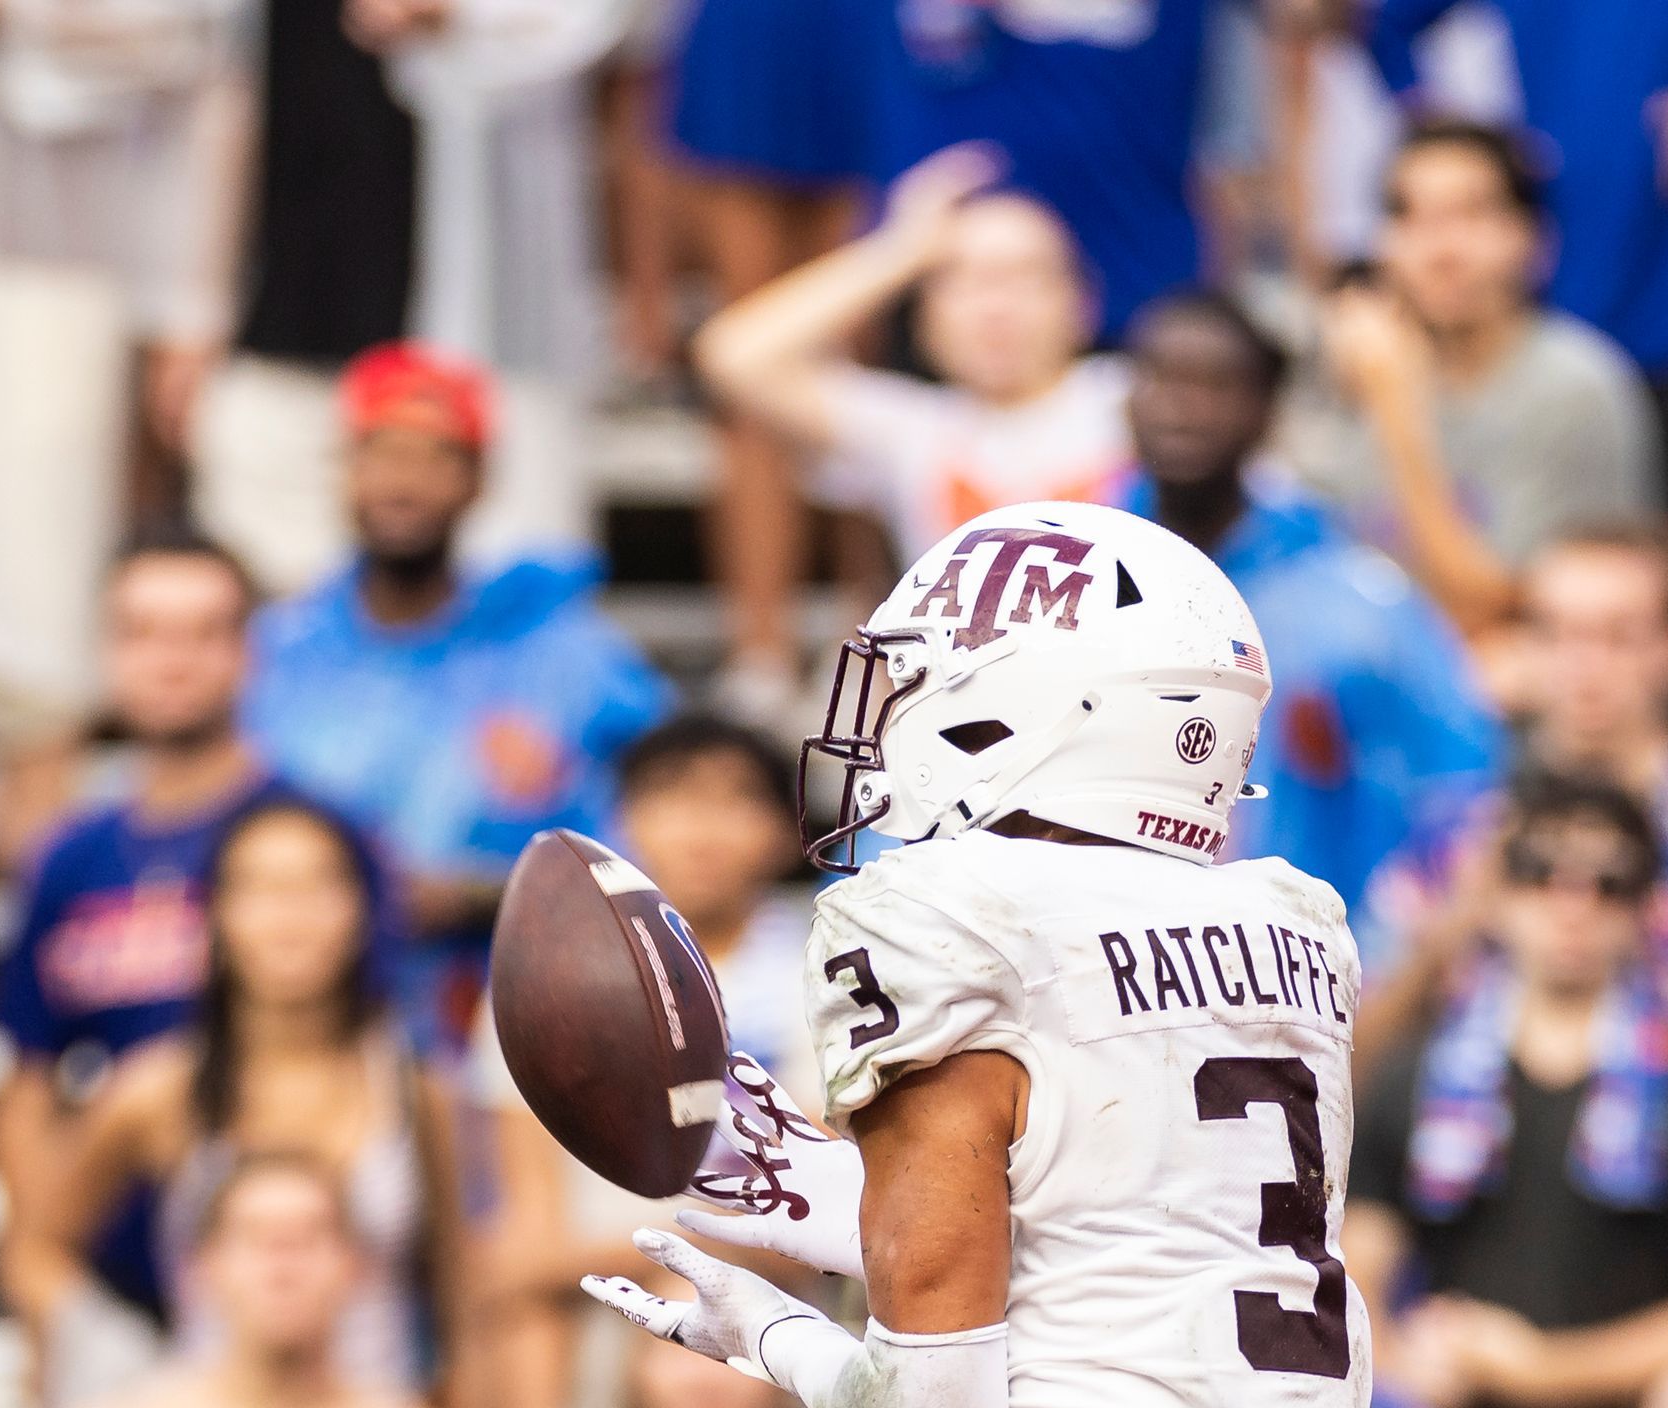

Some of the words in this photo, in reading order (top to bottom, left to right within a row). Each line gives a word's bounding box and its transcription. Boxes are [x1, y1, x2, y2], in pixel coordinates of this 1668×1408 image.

[1180, 722, 1213, 759] SEC
[1204, 781, 1224, 806] 3
[1137, 811, 1211, 851] TEXAS
[823, 946, 900, 1051] 3
[1098, 923, 1348, 1025] RATCLIFFE
[1192, 1056, 1351, 1381] 3
